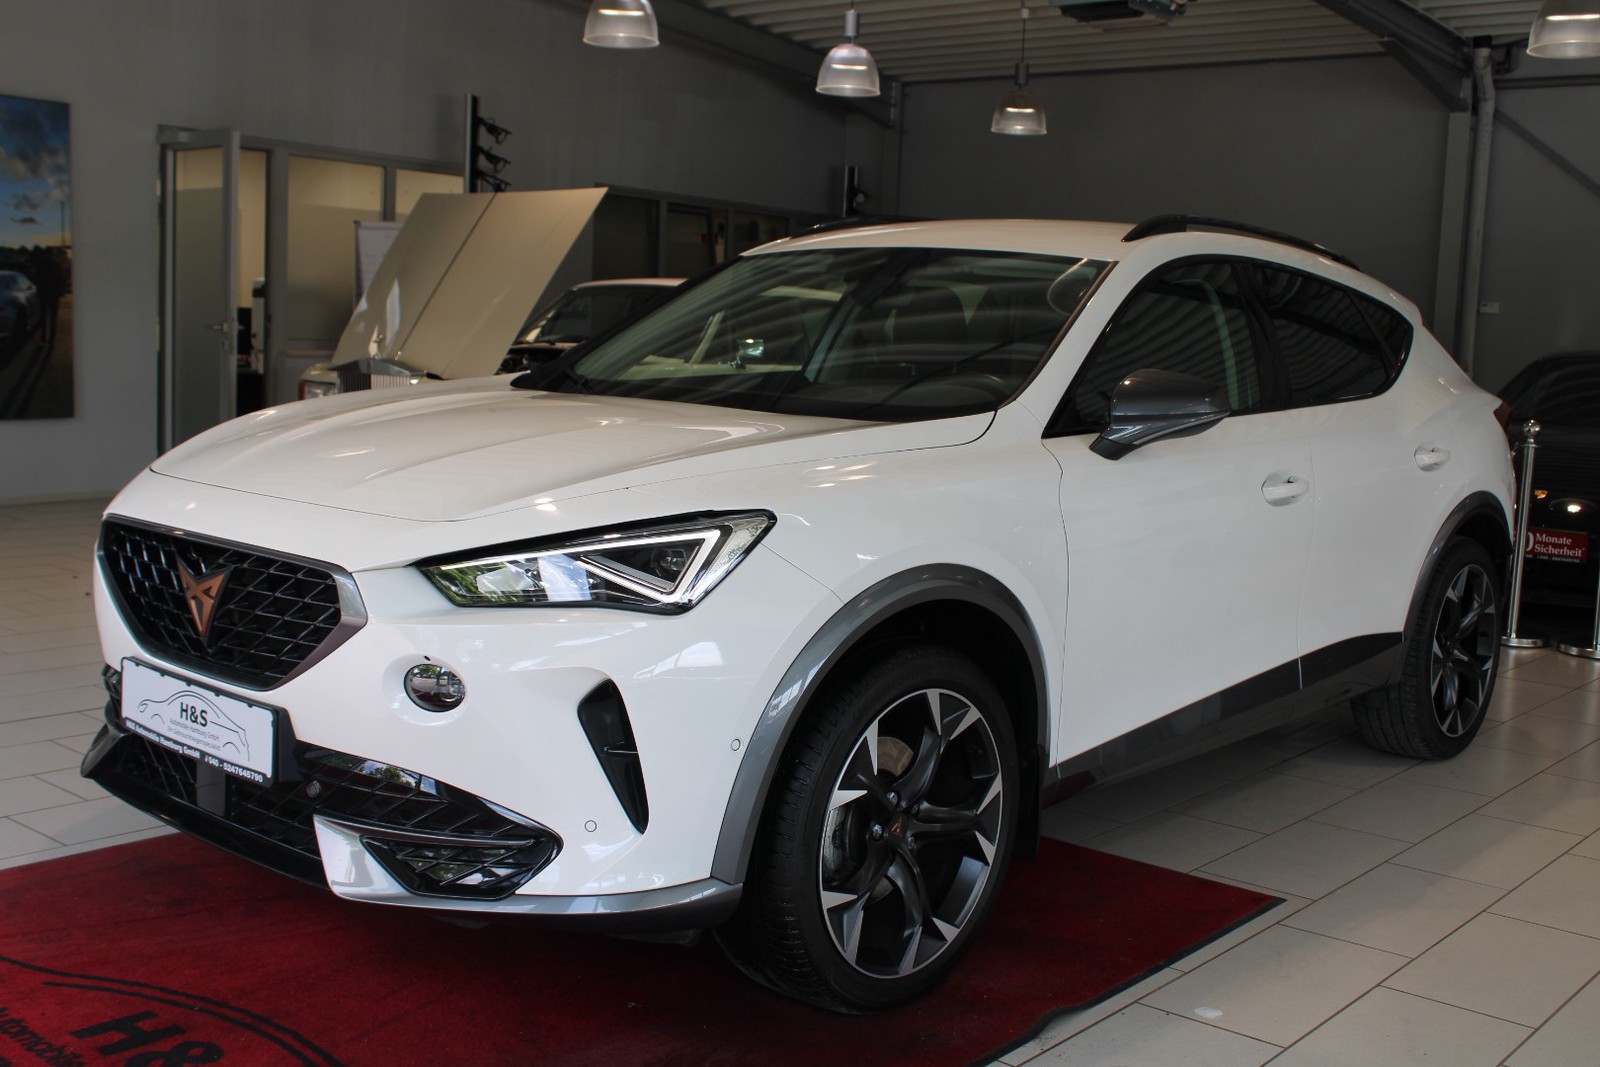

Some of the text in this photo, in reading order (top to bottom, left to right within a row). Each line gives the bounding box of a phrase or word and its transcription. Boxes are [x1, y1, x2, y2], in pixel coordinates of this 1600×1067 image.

[1536, 533, 1572, 545] Monate
[1534, 544, 1582, 557] Sicherheit
[180, 702, 208, 727] H&S
[223, 762, 264, 783] 5247645790
